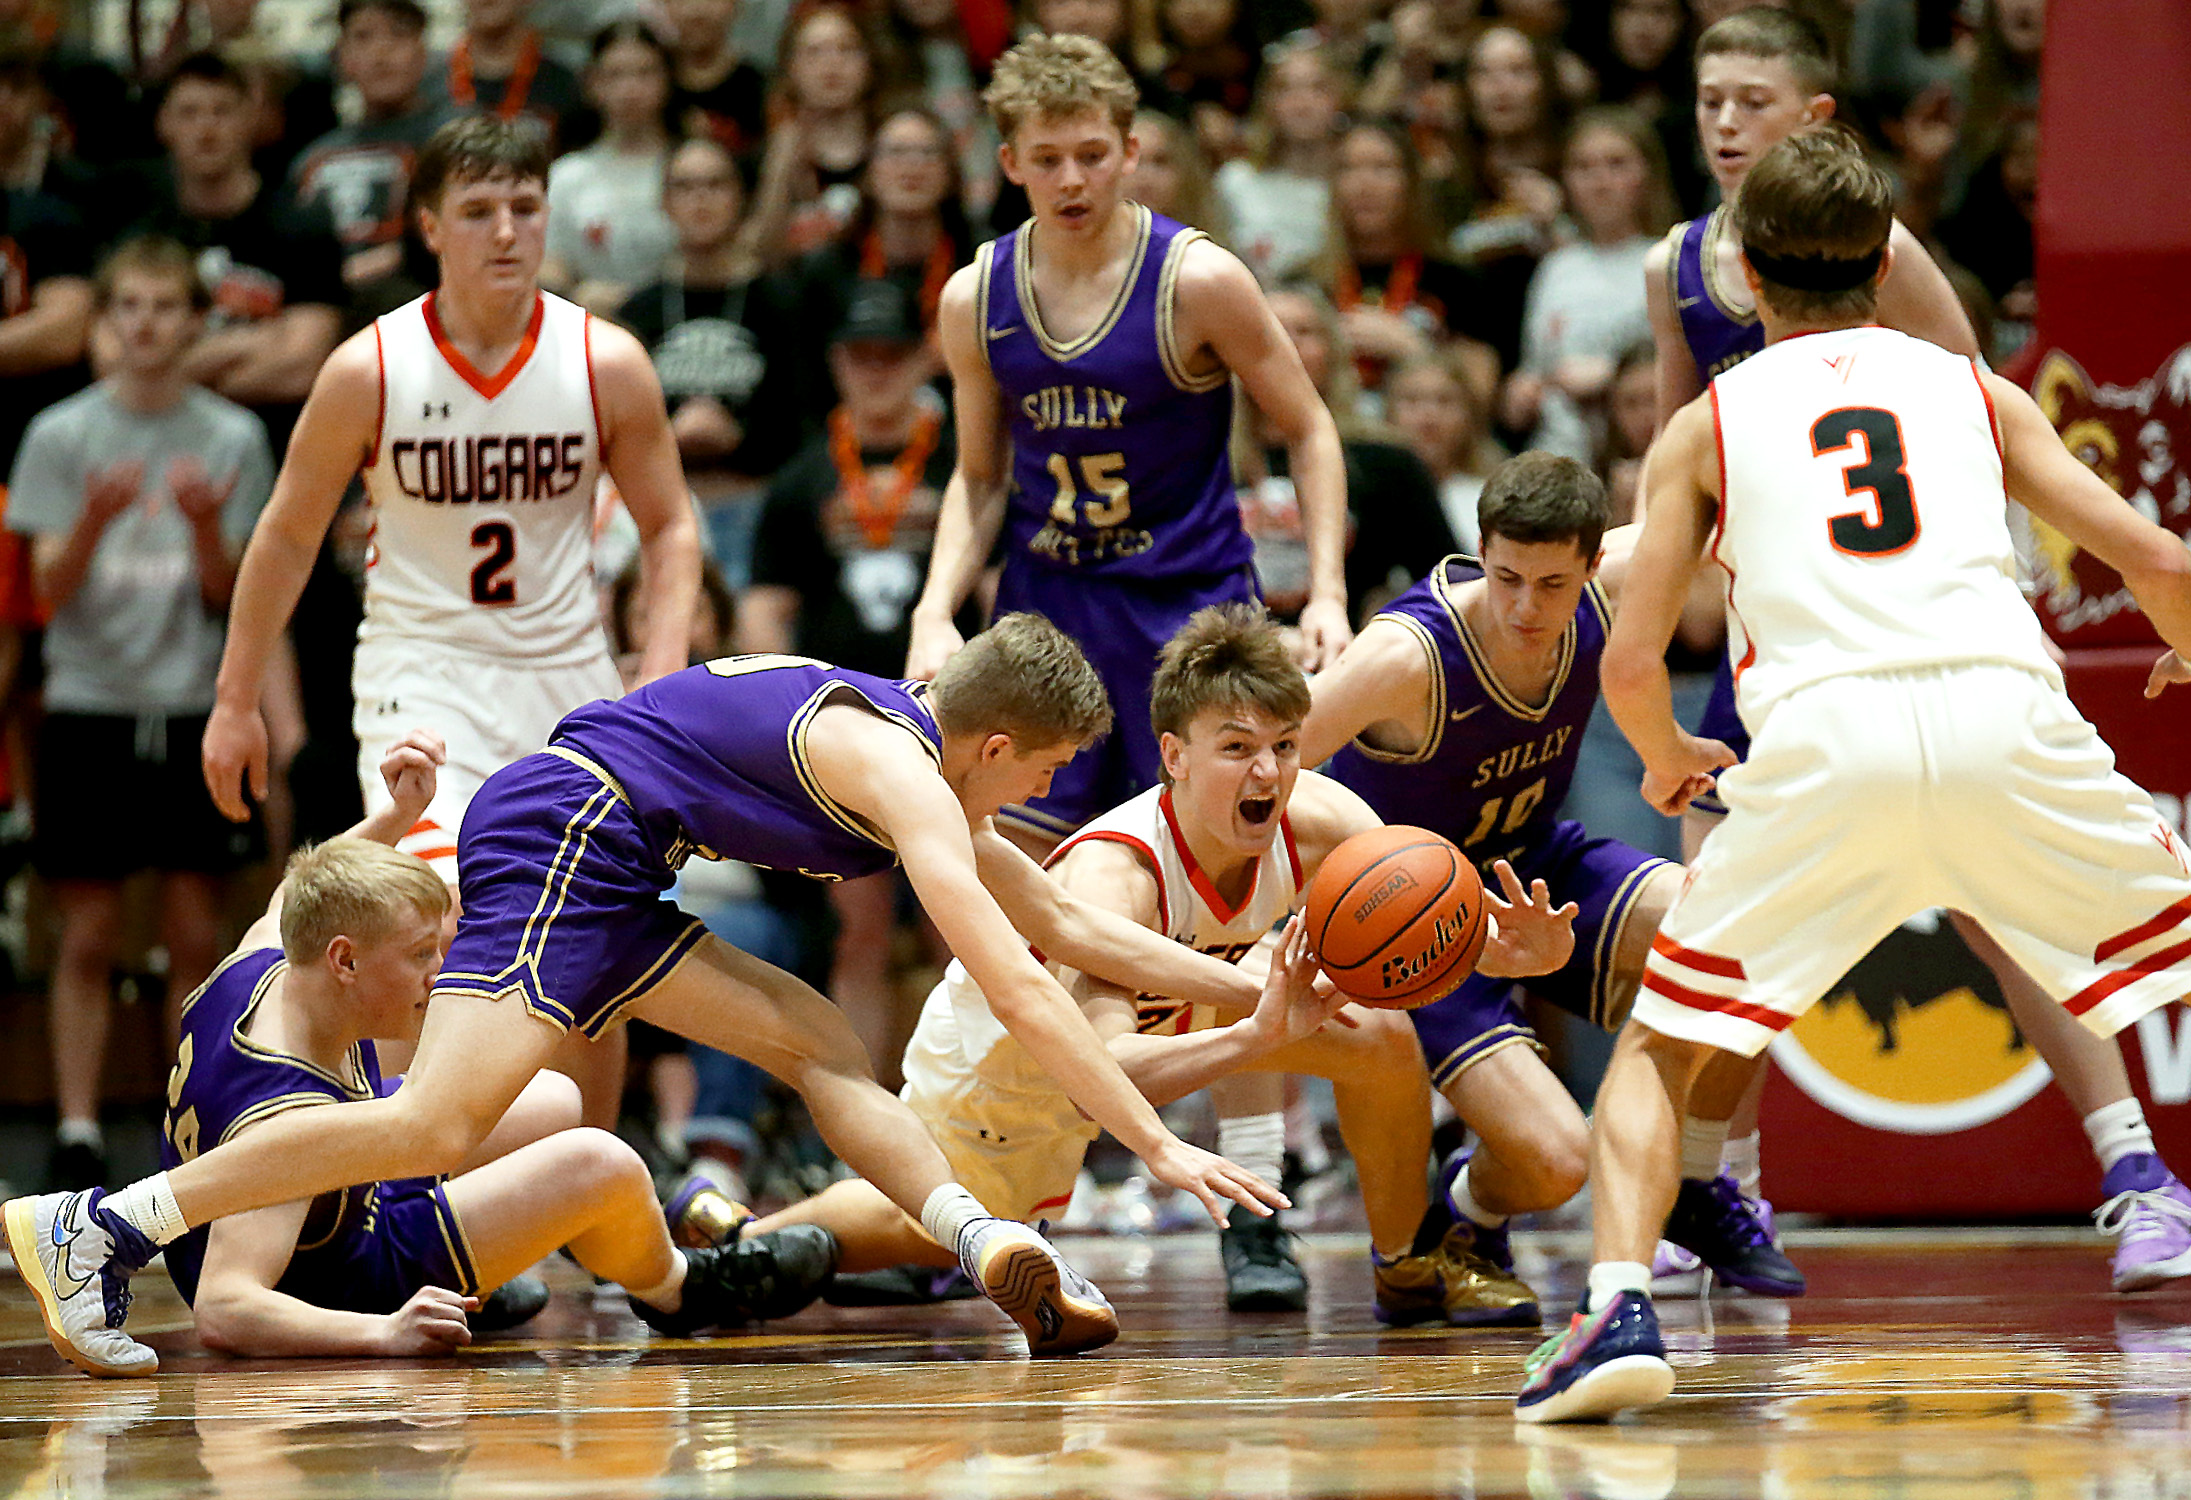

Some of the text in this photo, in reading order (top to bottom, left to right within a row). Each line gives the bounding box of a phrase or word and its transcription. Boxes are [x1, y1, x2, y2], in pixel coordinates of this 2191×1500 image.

[1021, 384, 1128, 432] SULLY
[392, 434, 584, 504] COUGARS
[1046, 452, 1132, 528] 15
[1809, 405, 1922, 558] 3
[470, 519, 517, 605] 2
[1471, 725, 1573, 789] SULLY
[1463, 776, 1547, 848] 10
[1381, 901, 1469, 989] Baden
